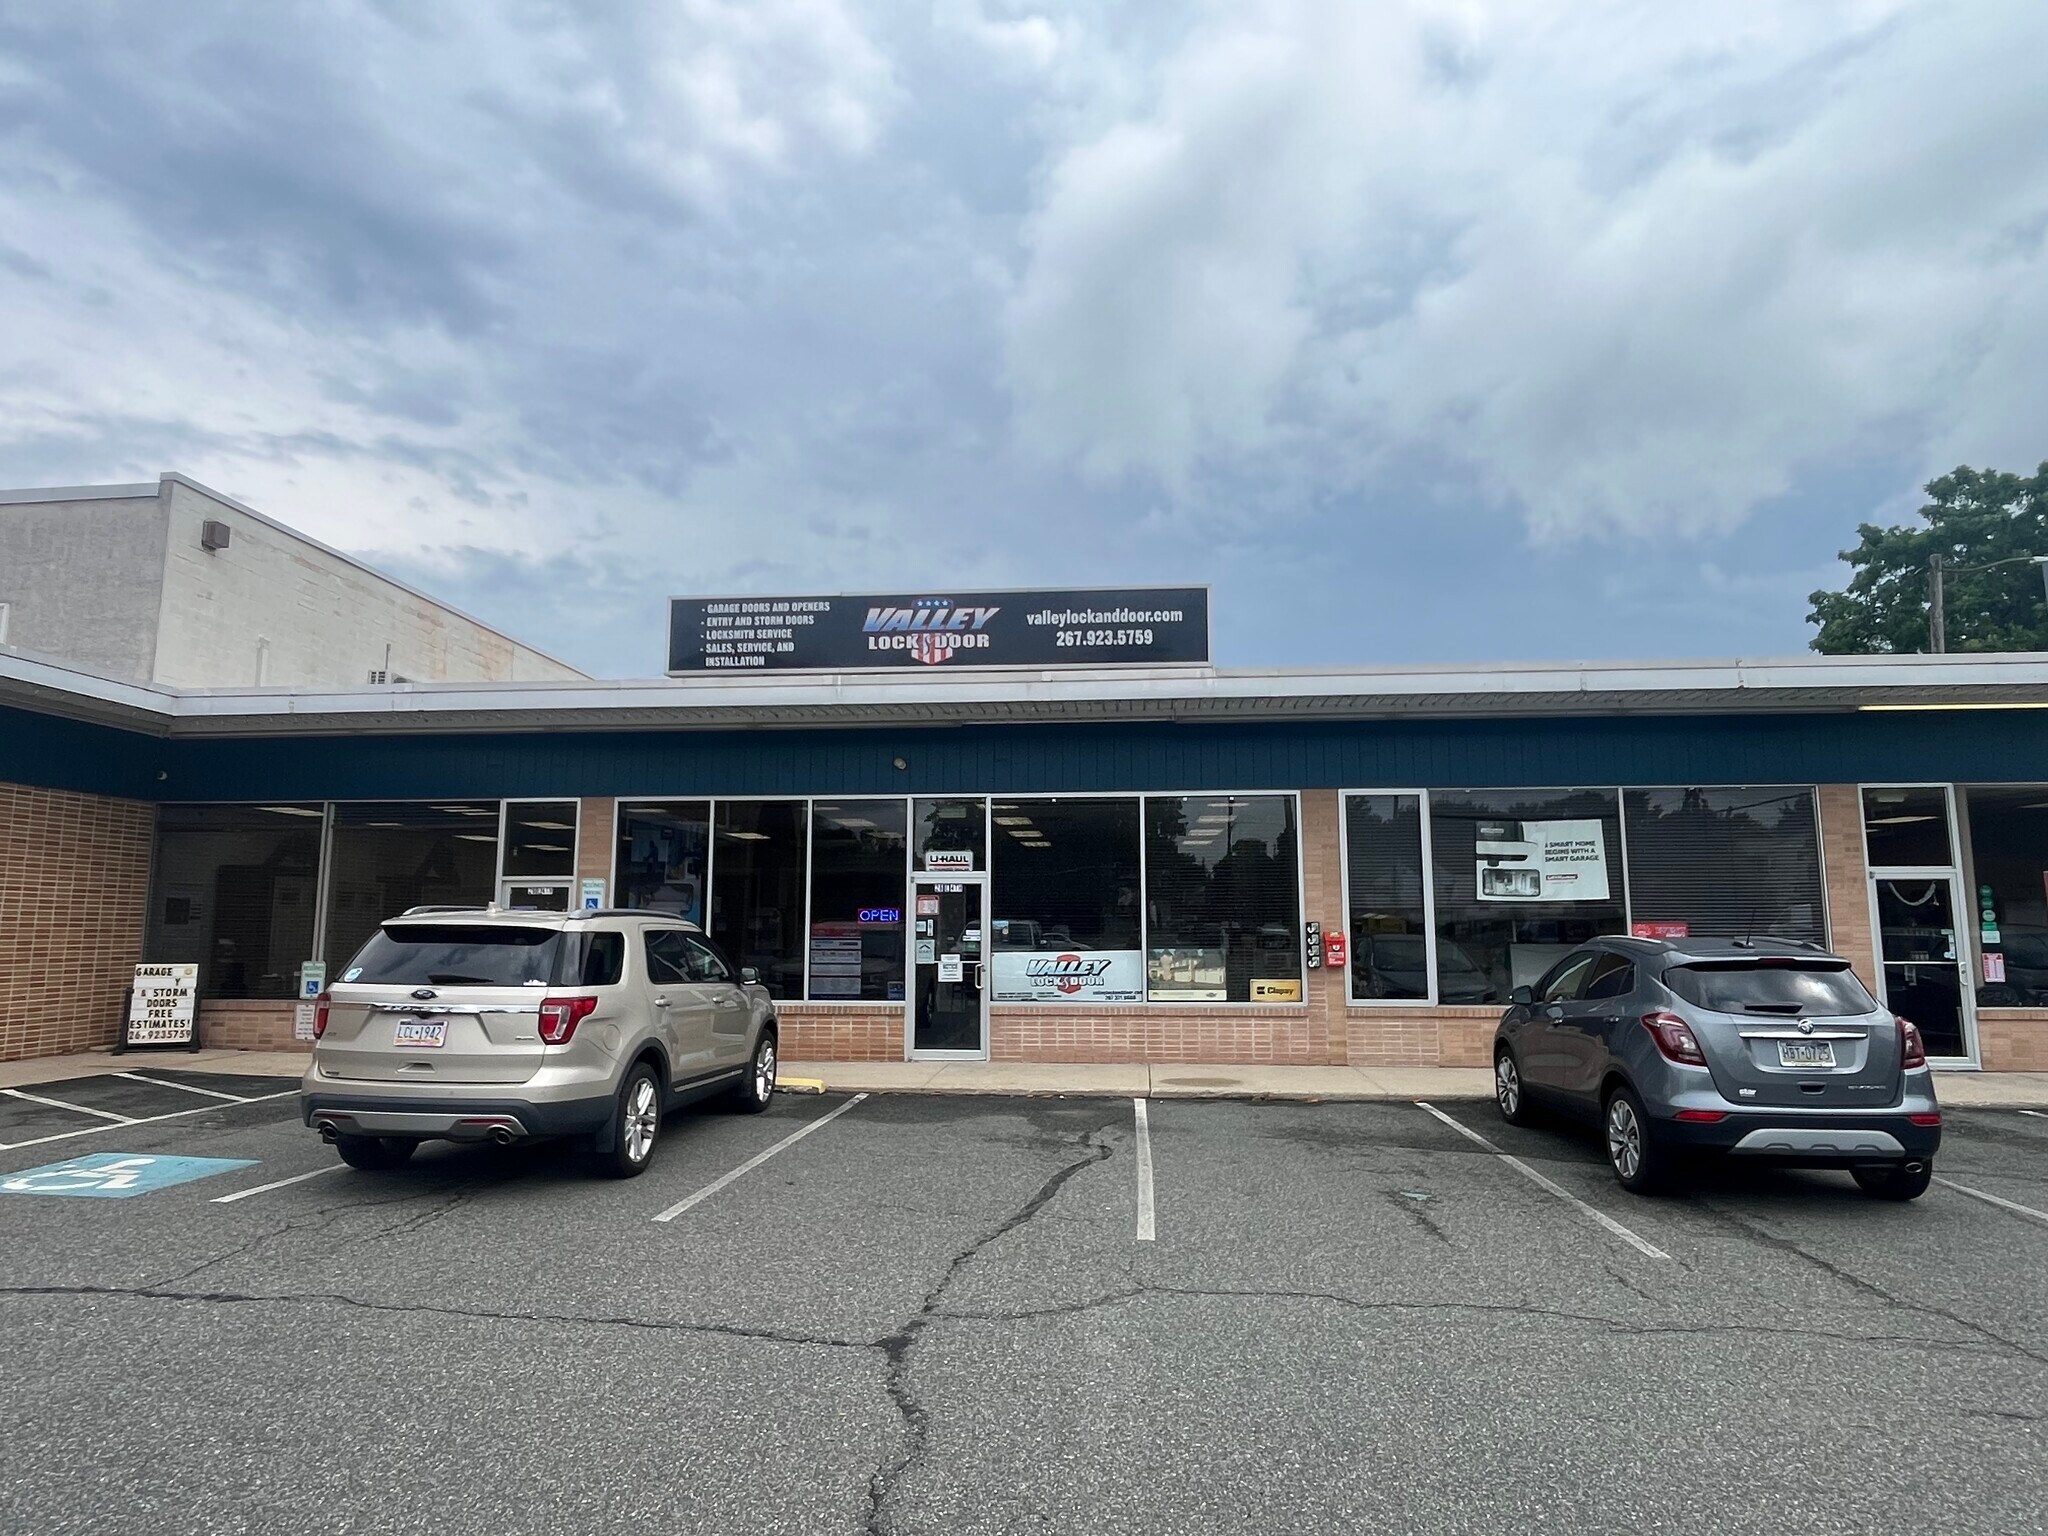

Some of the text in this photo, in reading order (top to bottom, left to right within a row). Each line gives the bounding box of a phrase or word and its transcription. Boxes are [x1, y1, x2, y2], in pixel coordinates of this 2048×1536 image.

[707, 601, 830, 614] GARAGE DOORS AND OPENERS
[706, 615, 814, 627] ENTRY AND STORM DOORS
[862, 607, 1002, 632] VALLEY
[1026, 608, 1183, 627] valleylockanddoor.com
[706, 628, 793, 640] LOCKSMITH SERVICE
[1056, 629, 1153, 646] 267.923.5759
[705, 641, 795, 654] SALES, SERVICE, AND
[868, 633, 990, 651] LOCK DOOR
[705, 655, 765, 667] INSTALLATION
[930, 855, 969, 863] U-HAUL
[859, 910, 899, 921] OPEN
[135, 967, 173, 977] GARAGE
[1025, 959, 1112, 977] VALLEY
[175, 978, 181, 986] Y
[1030, 976, 1105, 987] LOCK DOOR
[153, 988, 188, 997] STORM
[146, 999, 178, 1008] DOORS
[147, 1009, 173, 1018] FREE
[129, 1019, 191, 1029] ESTIMATES!
